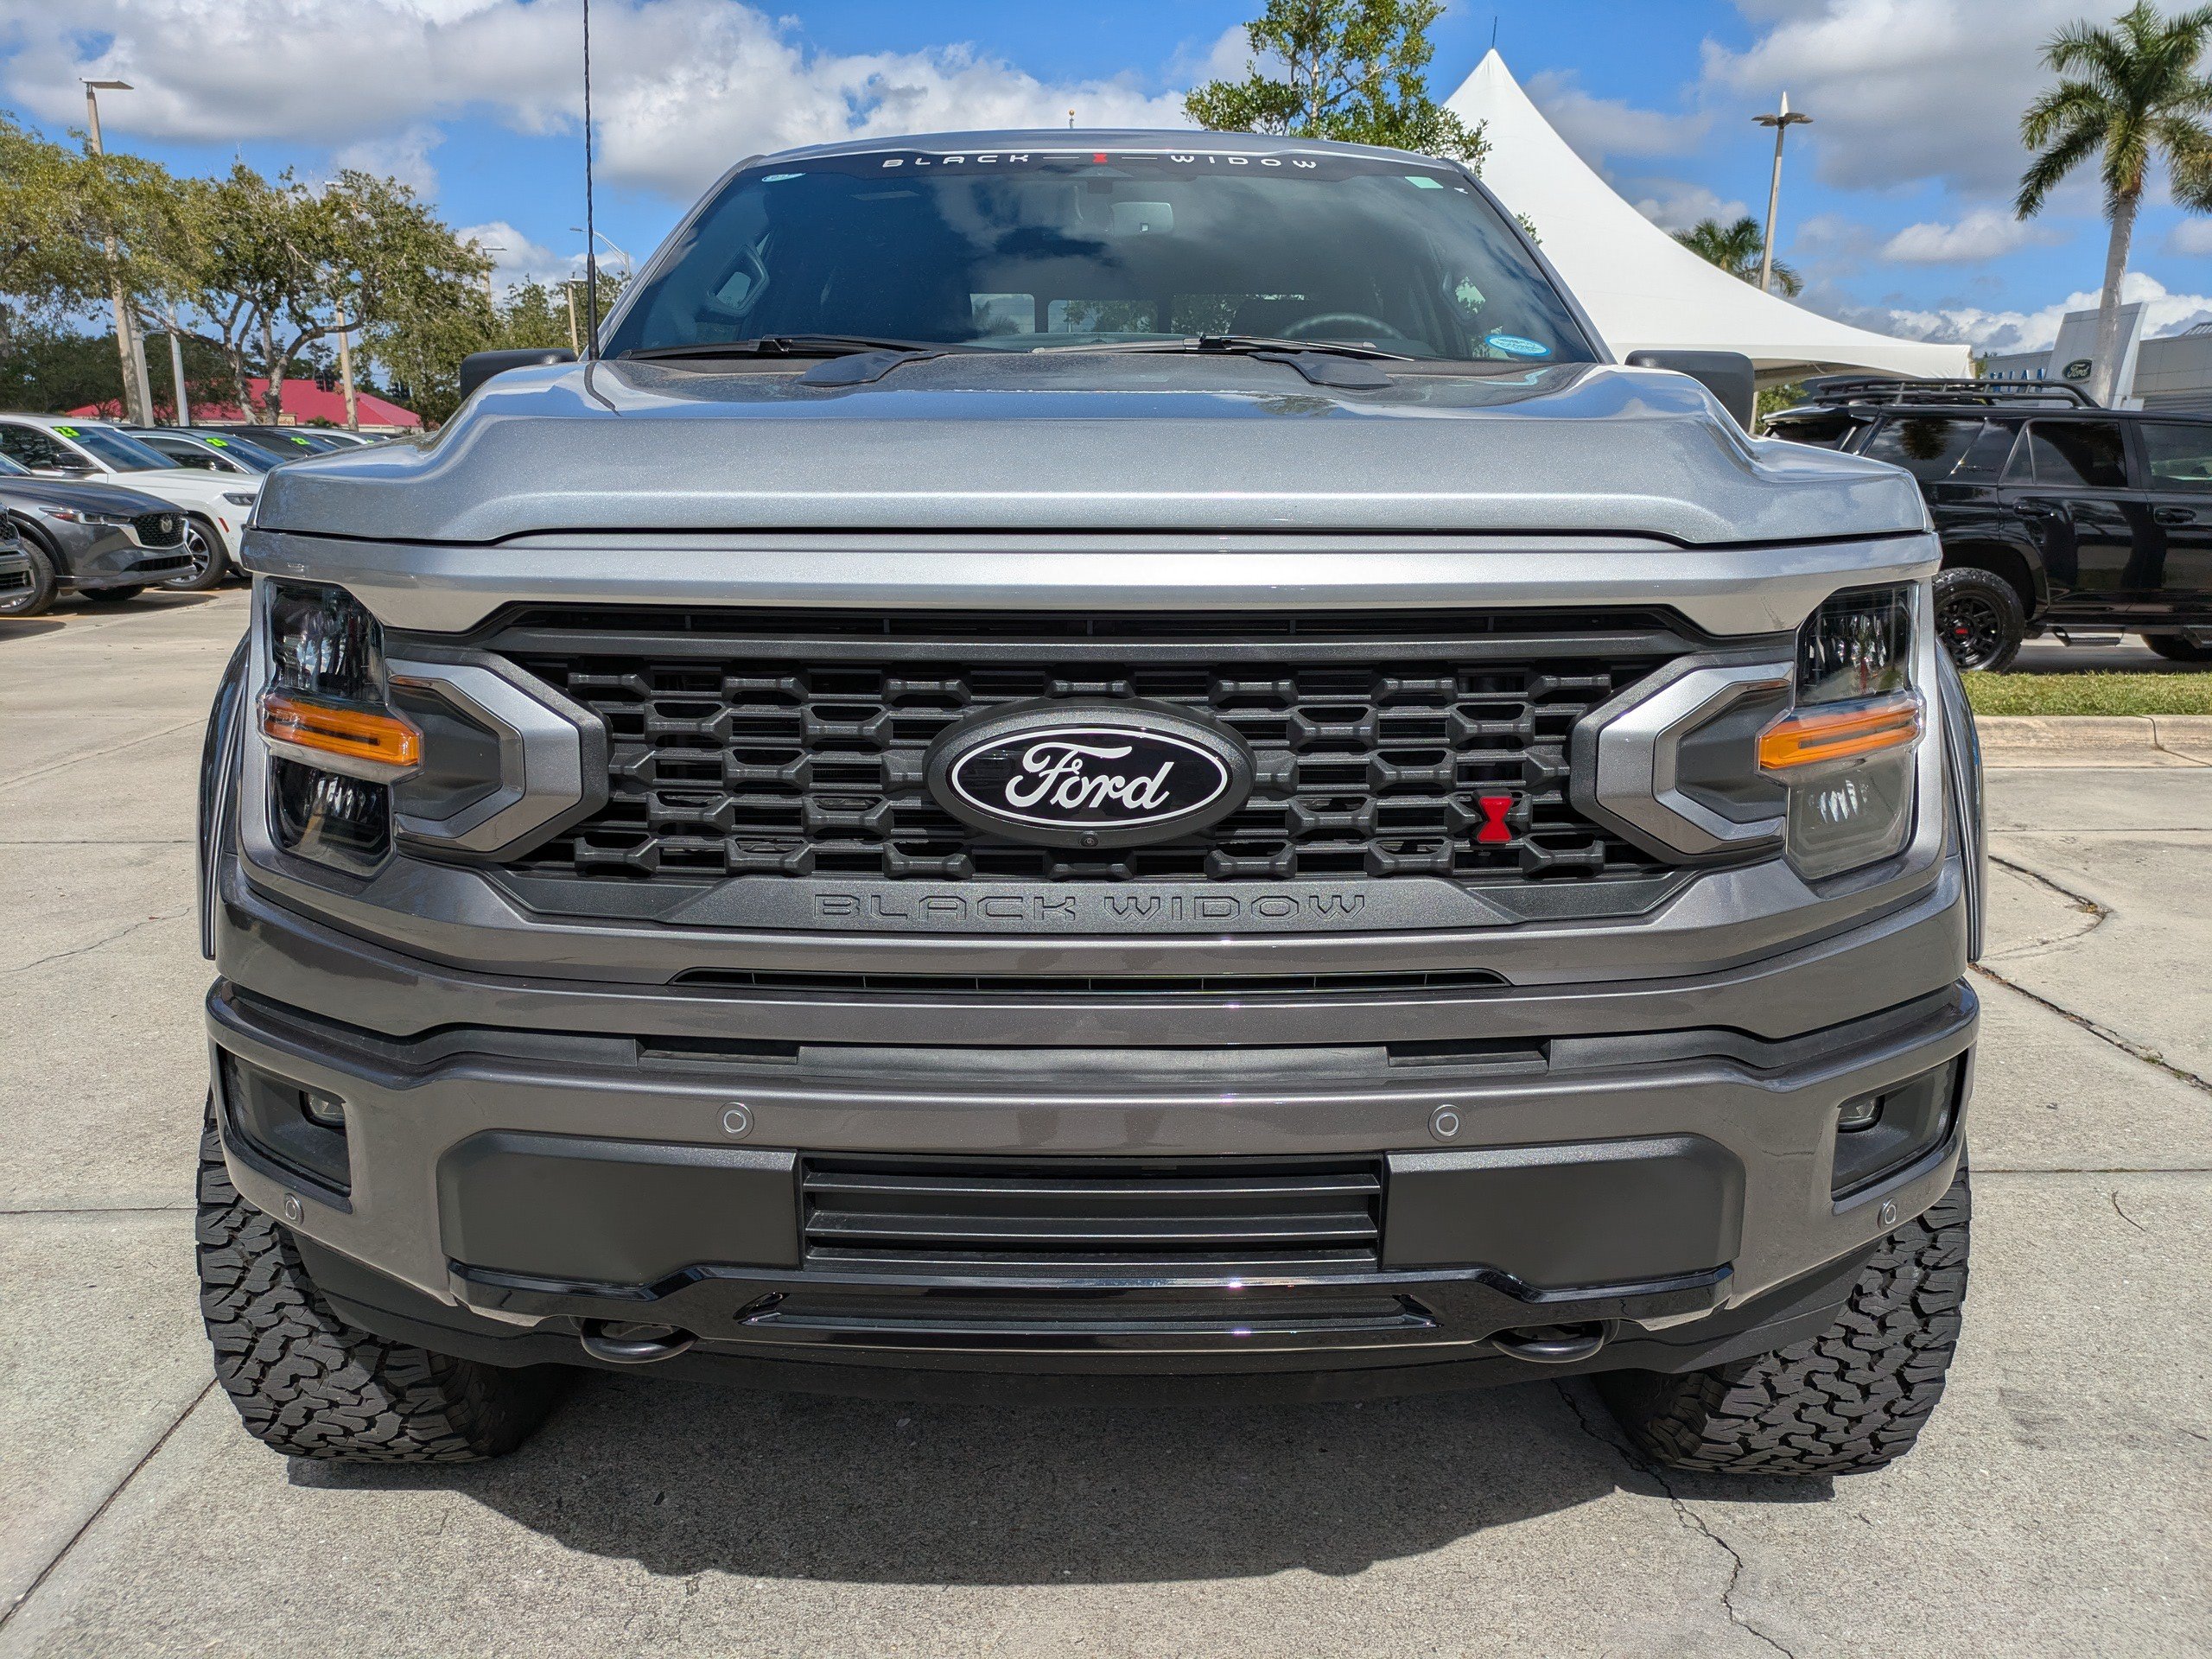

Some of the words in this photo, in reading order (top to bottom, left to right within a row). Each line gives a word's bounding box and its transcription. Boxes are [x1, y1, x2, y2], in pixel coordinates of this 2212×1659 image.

[882, 155, 1028, 168] BLACK
[1170, 155, 1317, 168] WIDOW
[2067, 363, 2091, 378] Ford
[54, 427, 80, 437] 23
[1005, 741, 1174, 810] Ford
[814, 893, 1076, 921] BLACK
[1103, 894, 1365, 921] WIDOW
